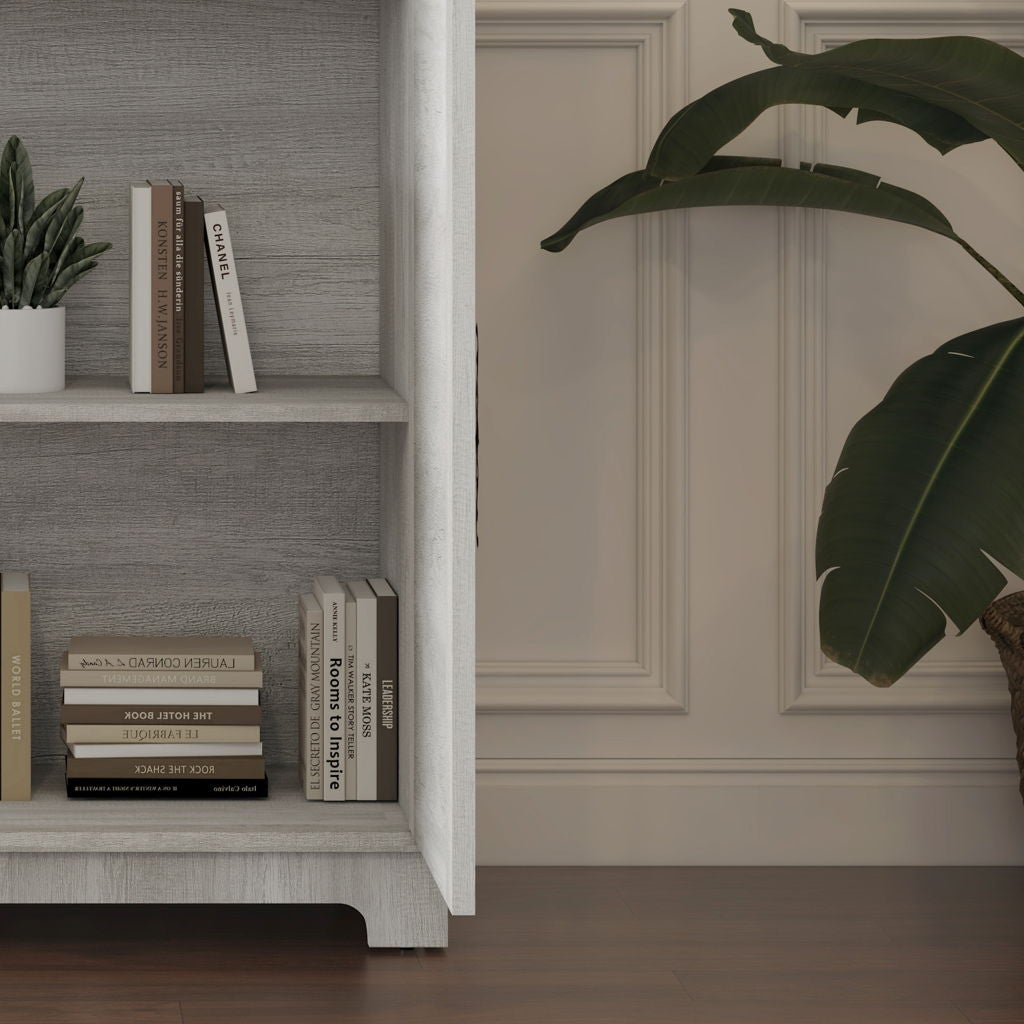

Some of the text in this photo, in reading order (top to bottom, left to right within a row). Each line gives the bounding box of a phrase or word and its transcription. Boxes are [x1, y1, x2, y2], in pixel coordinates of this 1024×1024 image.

[175, 191, 183, 215] saum
[175, 217, 184, 234] für
[175, 235, 184, 252] alla
[175, 253, 184, 270] die
[212, 223, 231, 281] CHANEL
[156, 220, 168, 369] KONSTEN H.W.JANSON
[175, 271, 184, 312] sünderin
[11, 655, 21, 741] WORLD BALLET
[309, 622, 320, 791] EL SECRETO DE GRAY MOUNTAIN
[326, 658, 343, 790] Rooms to Inspire
[347, 655, 355, 760] TIM WALKER STORY TELLER
[362, 673, 372, 738] KATE MOSS
[381, 679, 394, 729] LEADERSHIP
